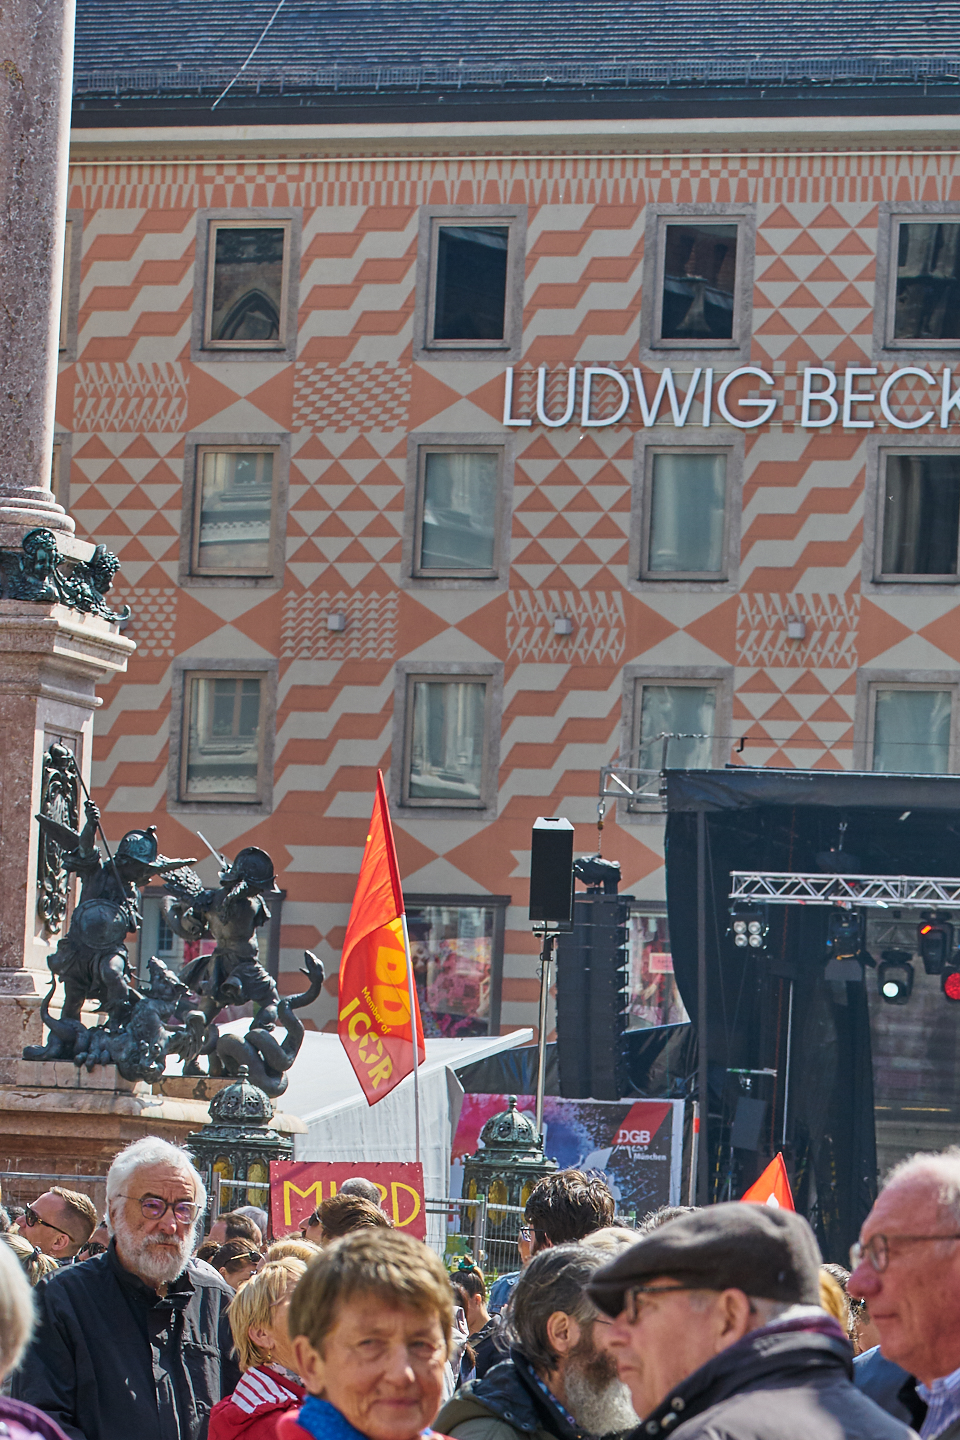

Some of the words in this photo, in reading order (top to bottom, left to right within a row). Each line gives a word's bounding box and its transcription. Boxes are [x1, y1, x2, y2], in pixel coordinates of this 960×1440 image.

[502, 366, 777, 428] LUDWIG
[361, 986, 384, 1023] Member
[381, 1024, 392, 1035] of
[339, 997, 393, 1090] ICOR
[617, 1129, 651, 1144] DGB
[283, 1181, 421, 1227] MD
